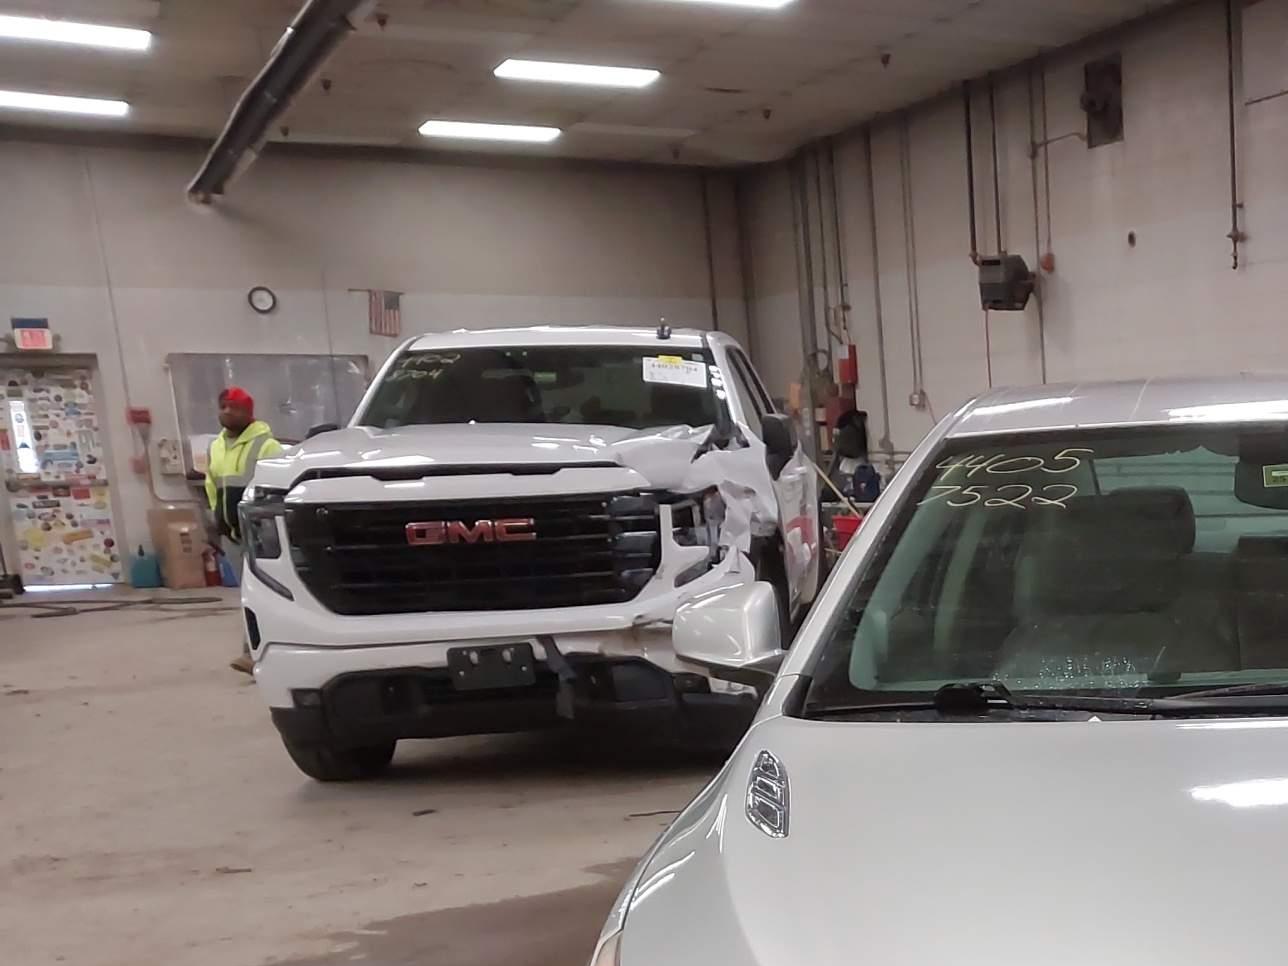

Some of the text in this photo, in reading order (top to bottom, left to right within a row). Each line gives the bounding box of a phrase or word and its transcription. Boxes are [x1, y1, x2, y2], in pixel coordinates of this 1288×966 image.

[935, 448, 1094, 481] 4405
[916, 484, 1078, 510] 7522
[405, 518, 536, 546] GMC
